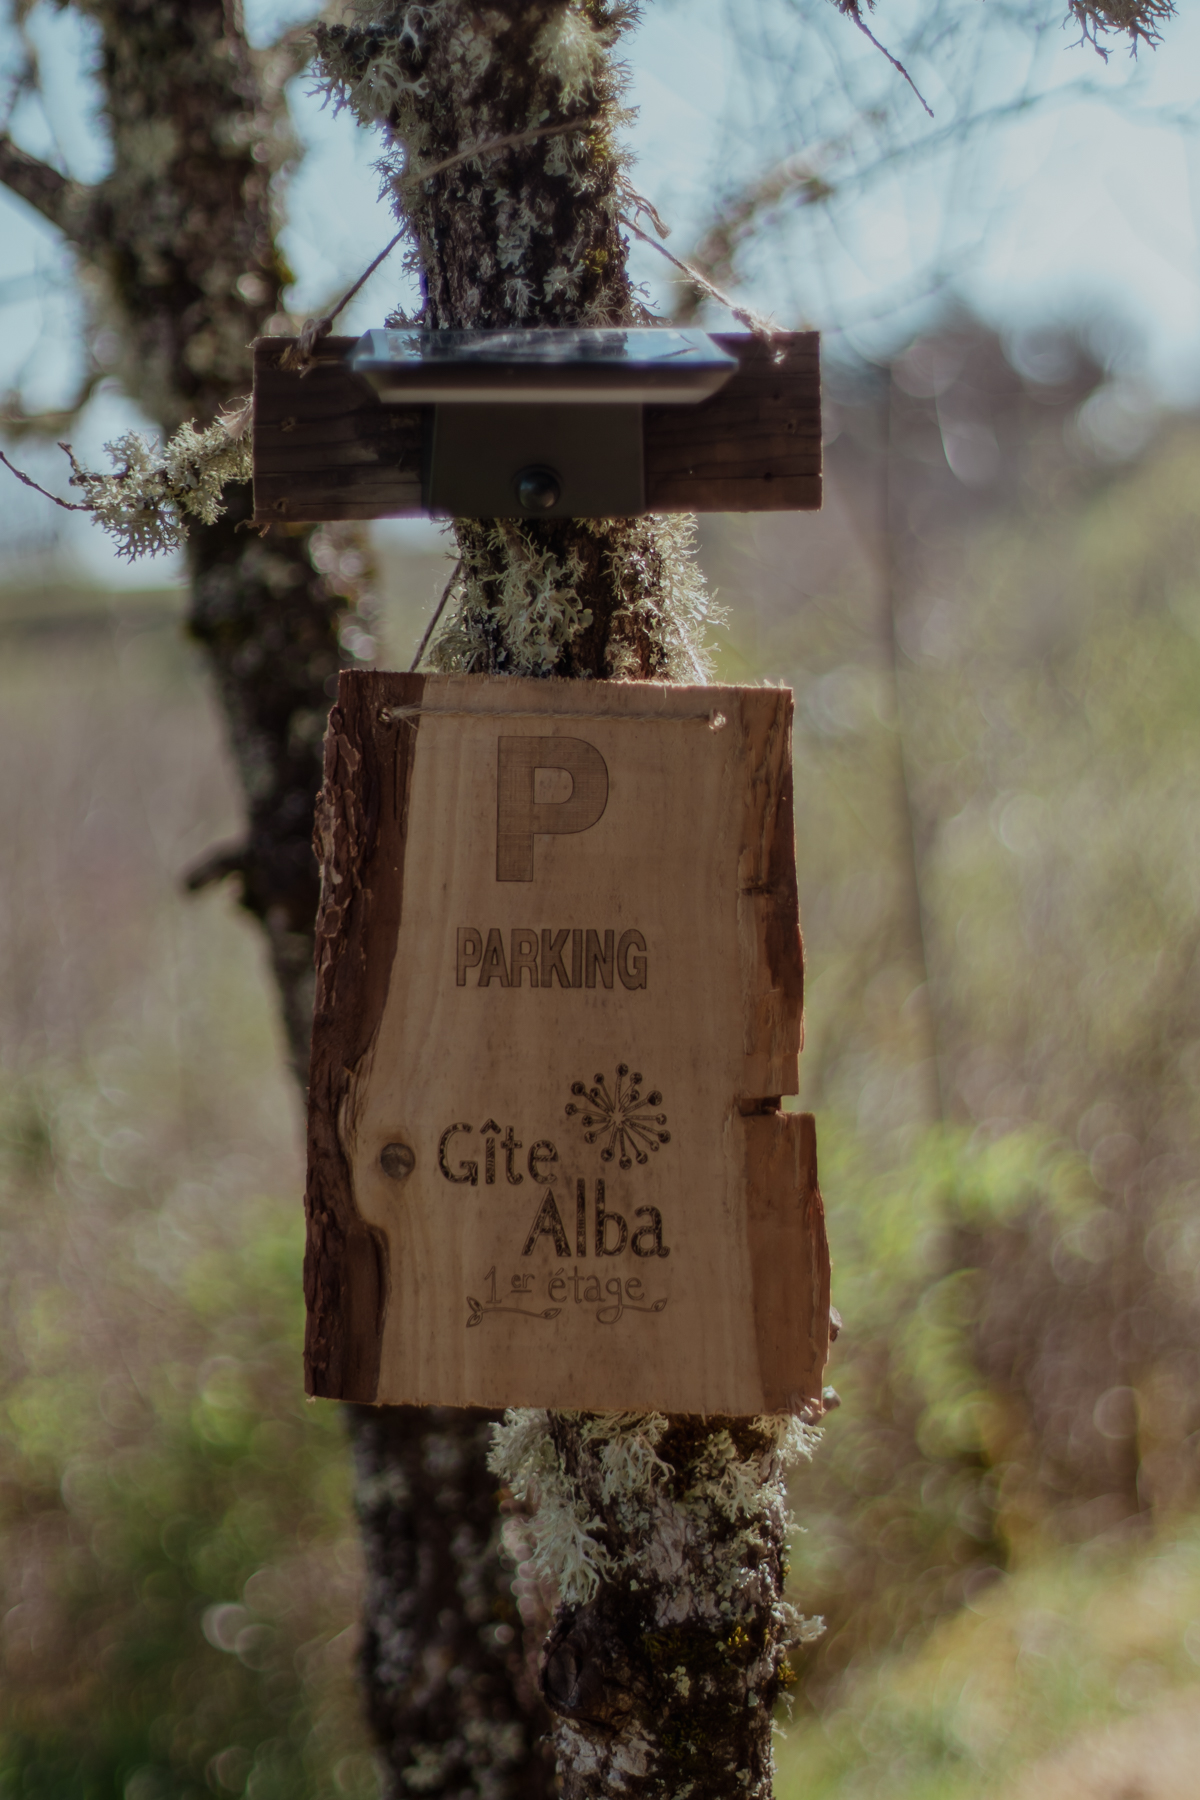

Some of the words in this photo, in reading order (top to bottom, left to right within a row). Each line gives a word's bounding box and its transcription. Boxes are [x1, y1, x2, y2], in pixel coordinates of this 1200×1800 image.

[496, 736, 609, 882] P
[456, 927, 647, 990] PARKING
[438, 1118, 558, 1186] Gîte
[521, 1178, 671, 1258] Alba
[547, 1266, 646, 1324] étage
